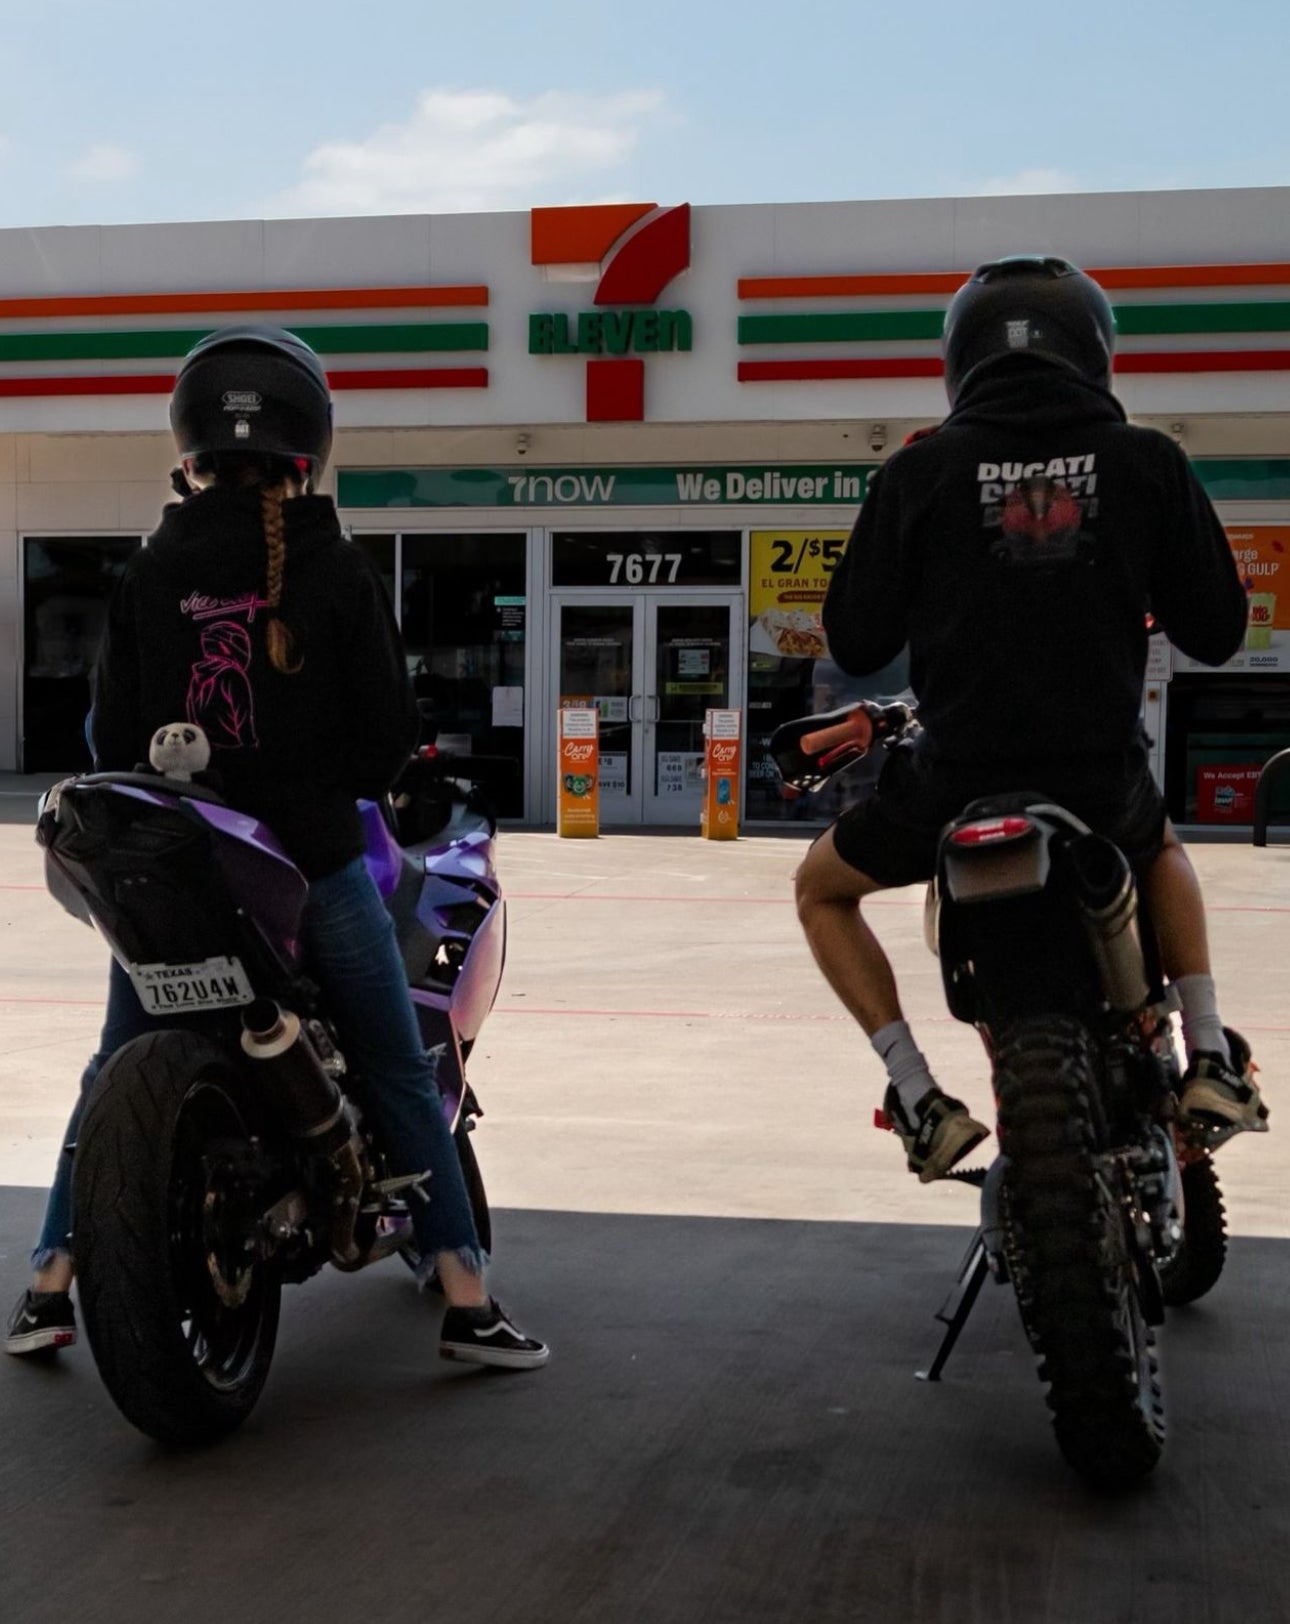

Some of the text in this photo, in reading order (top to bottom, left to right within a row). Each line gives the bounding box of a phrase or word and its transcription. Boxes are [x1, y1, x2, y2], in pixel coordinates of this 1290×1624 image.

[977, 453, 1097, 482] DUCATI
[676, 473, 721, 500] We
[726, 470, 829, 500] Deliver
[833, 470, 860, 499] in
[1231, 547, 1258, 563] arge
[606, 554, 682, 583] 7677
[1247, 562, 1279, 576] GULP
[761, 579, 828, 588] EL GRAN TO
[1203, 772, 1216, 780] We
[1217, 772, 1245, 781] Accept
[156, 968, 192, 978] TEXAS
